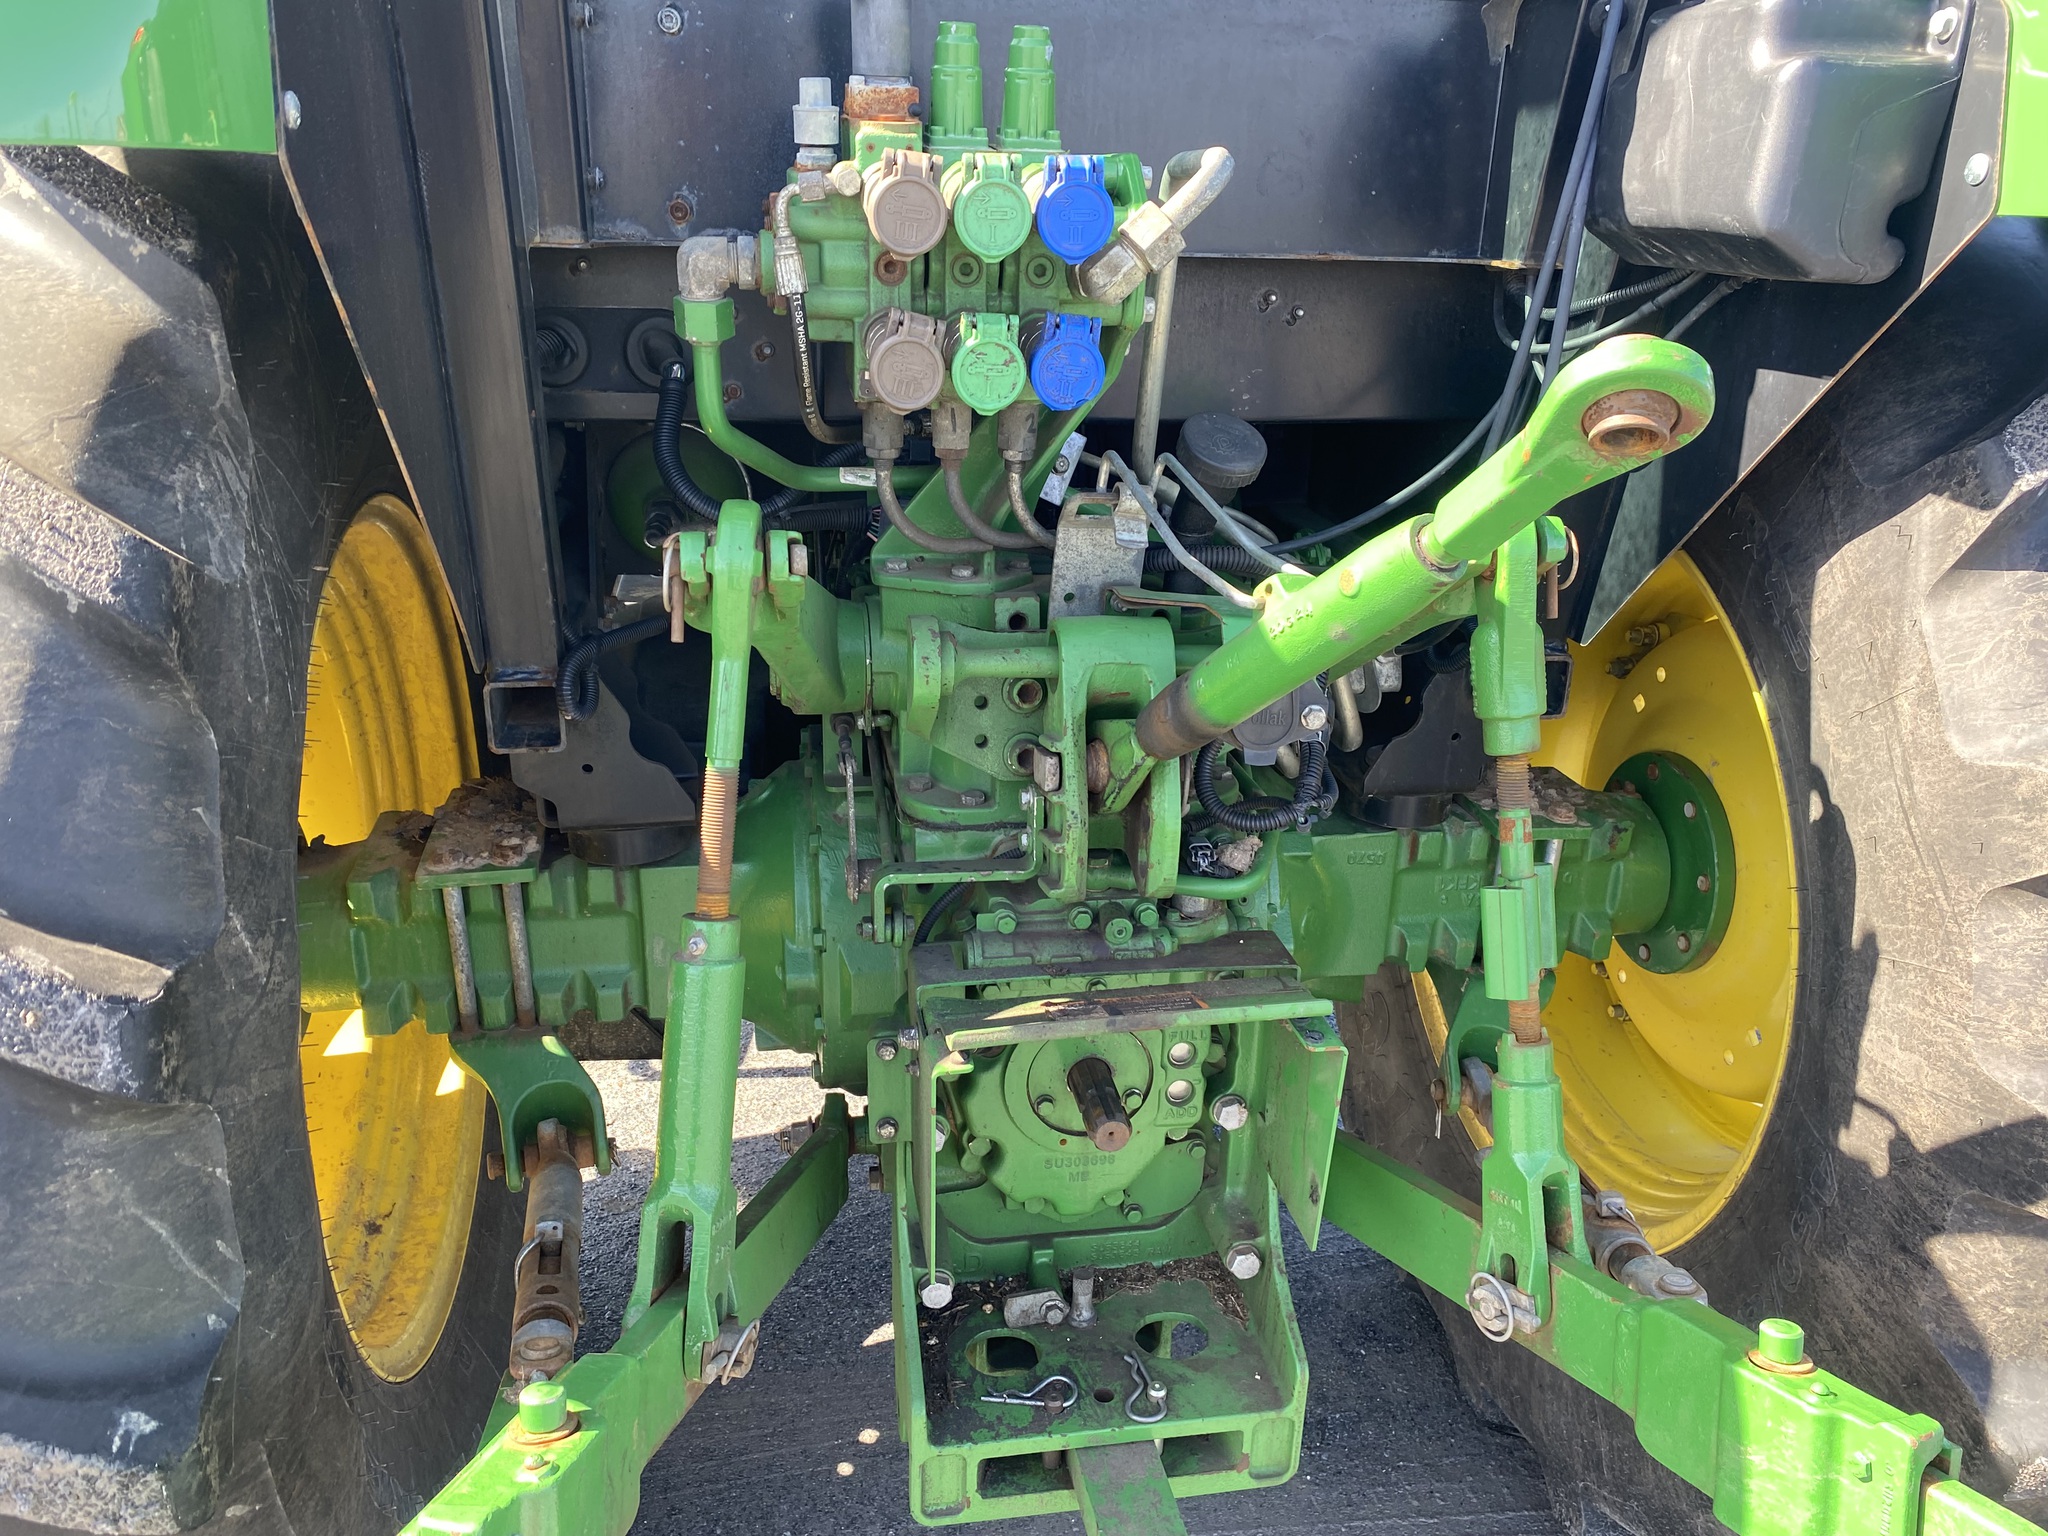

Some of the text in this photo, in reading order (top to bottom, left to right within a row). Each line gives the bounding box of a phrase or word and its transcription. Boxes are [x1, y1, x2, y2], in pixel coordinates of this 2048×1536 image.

[797, 325, 807, 351] MSHA
[799, 351, 811, 387] Resistant
[1024, 412, 1037, 433] 2
[1249, 709, 1287, 726] ollak
[1168, 1029, 1207, 1042] FULL
[1163, 1105, 1198, 1120] ADD
